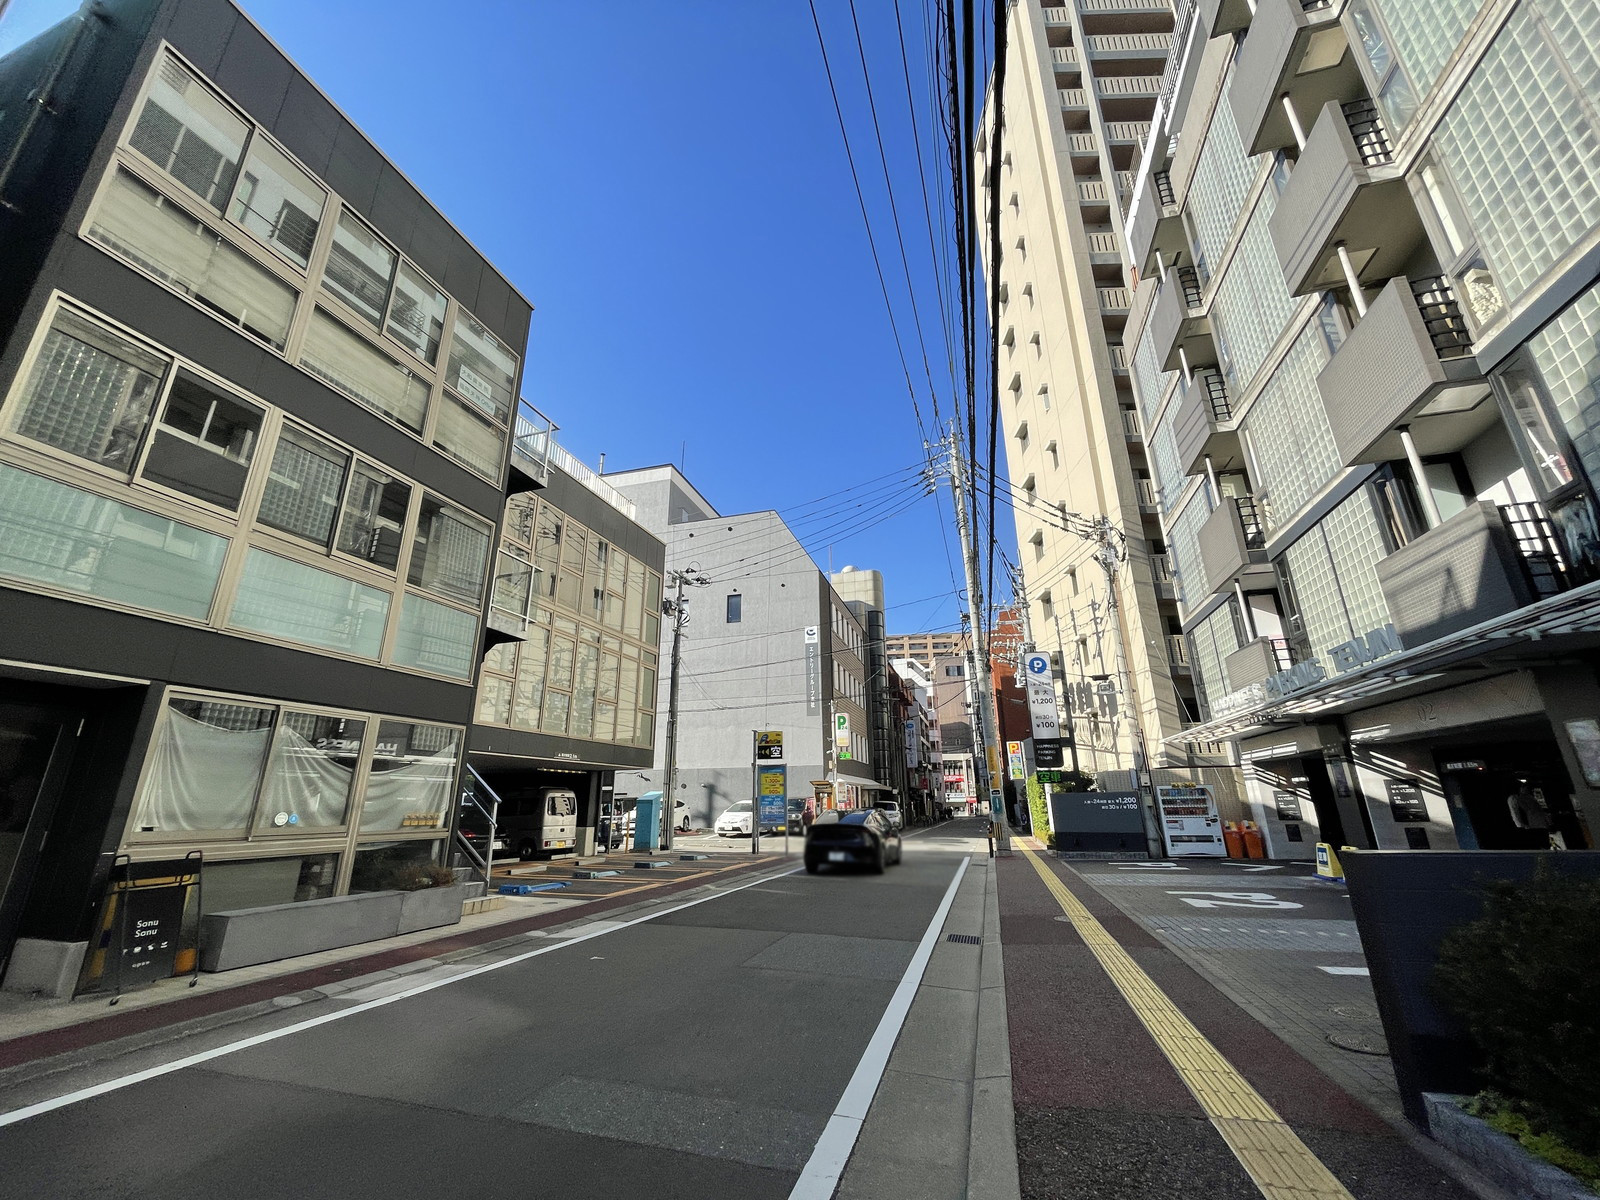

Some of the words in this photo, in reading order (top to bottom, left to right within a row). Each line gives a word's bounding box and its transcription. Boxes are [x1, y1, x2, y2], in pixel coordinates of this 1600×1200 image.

[1265, 657, 1325, 698] PARKING
[837, 716, 847, 730] P
[770, 746, 781, 757] 空
[1009, 743, 1018, 754] P
[1038, 771, 1061, 782] 空車
